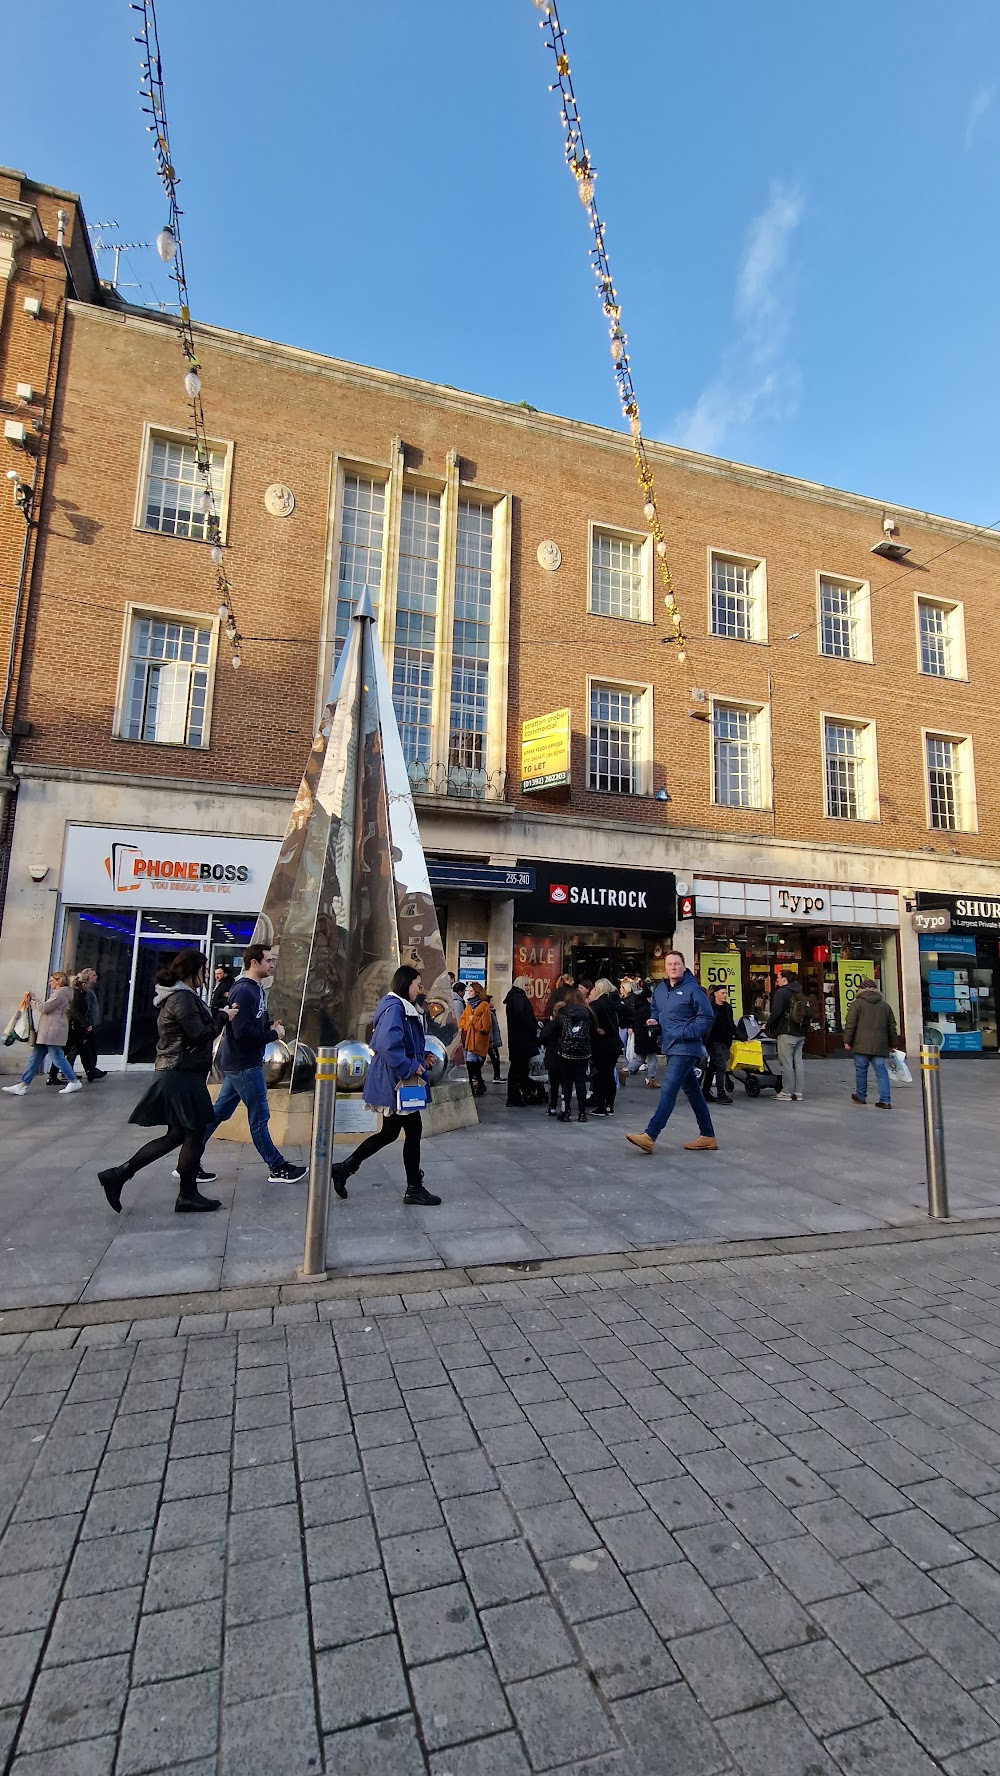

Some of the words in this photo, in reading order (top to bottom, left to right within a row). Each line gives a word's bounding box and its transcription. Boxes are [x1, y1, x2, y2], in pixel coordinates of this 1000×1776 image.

[547, 711, 567, 723] creber
[524, 721, 557, 737] commercial
[524, 765, 532, 774] TO
[534, 761, 547, 771] LET
[523, 776, 544, 789] (01392)
[545, 772, 566, 783] 202203
[133, 858, 249, 882] PHONEBOSS
[505, 873, 530, 885] 235-240
[150, 881, 169, 891] YOU
[170, 882, 201, 893] BREAK,
[203, 884, 216, 893] WE
[218, 885, 231, 894] FIX
[570, 886, 647, 909] SALTROCK
[778, 890, 824, 913] Typo
[915, 915, 945, 929] Typo
[957, 919, 978, 928] Largest
[978, 920, 998, 929] Private
[519, 946, 555, 964] SALE
[708, 967, 735, 983] 50%
